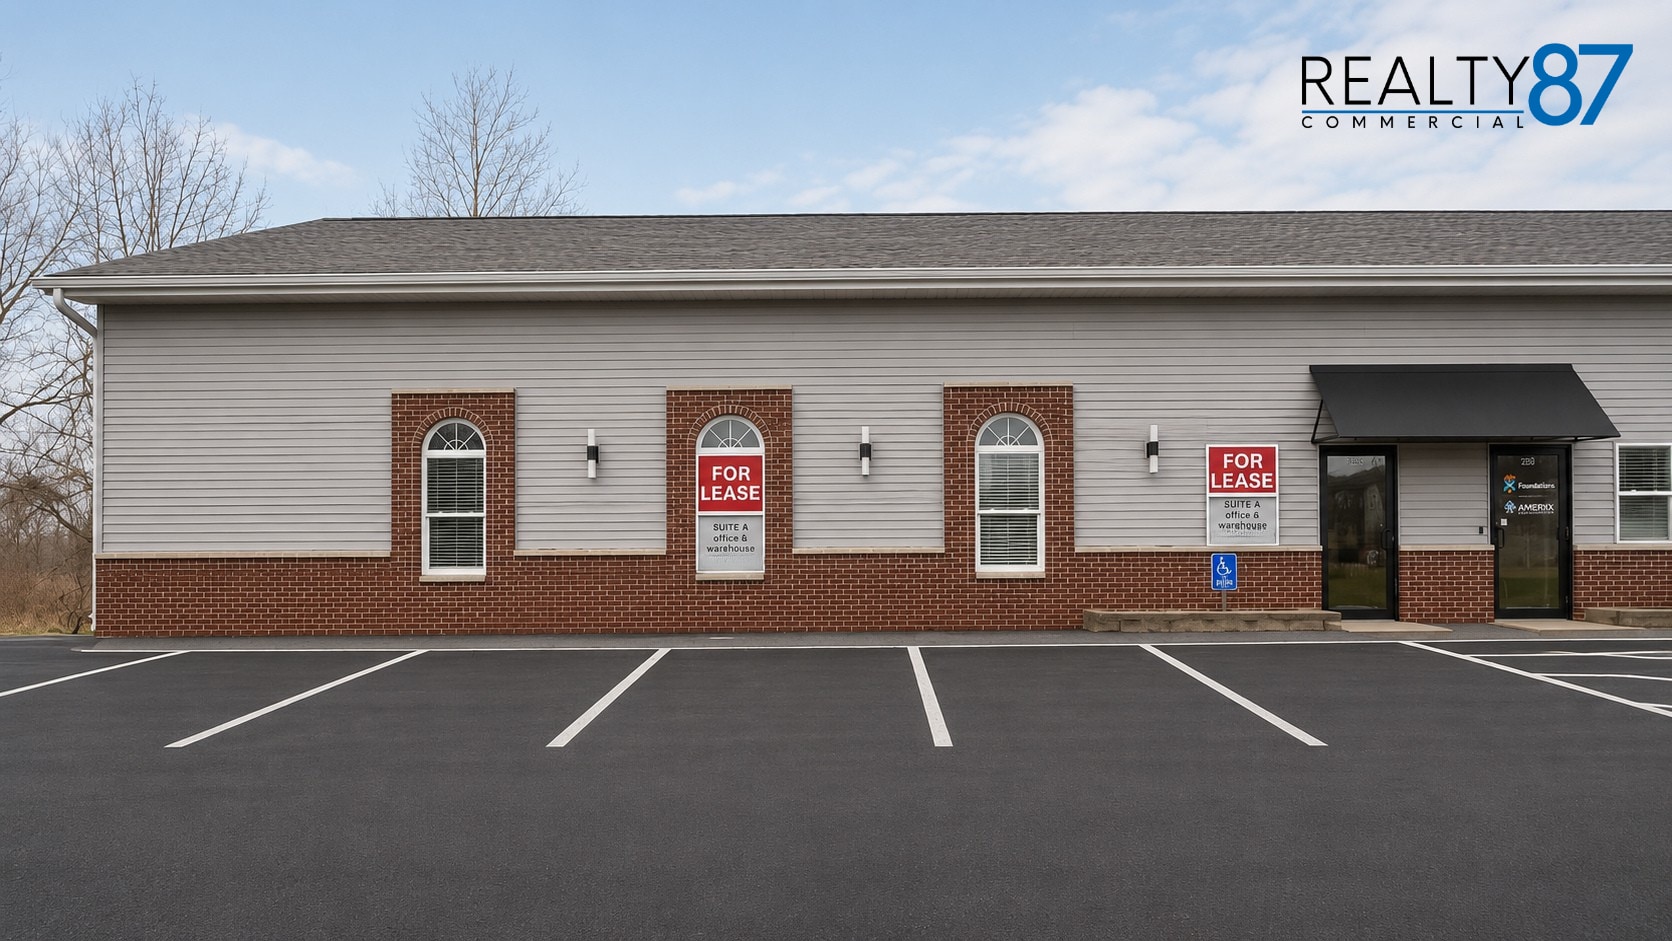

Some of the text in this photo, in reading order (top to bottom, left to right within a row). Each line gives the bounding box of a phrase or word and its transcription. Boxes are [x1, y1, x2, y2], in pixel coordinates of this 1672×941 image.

[1223, 453, 1263, 469] FOR
[712, 466, 751, 481] FOR
[1211, 472, 1273, 489] LEASE
[700, 485, 761, 501] LEASE
[1224, 500, 1261, 509] SUITE A
[1225, 511, 1250, 519] office
[713, 523, 749, 531] SUITE A
[1218, 521, 1267, 531] warehouse
[713, 534, 748, 542] office &
[706, 544, 755, 553] warehouse
